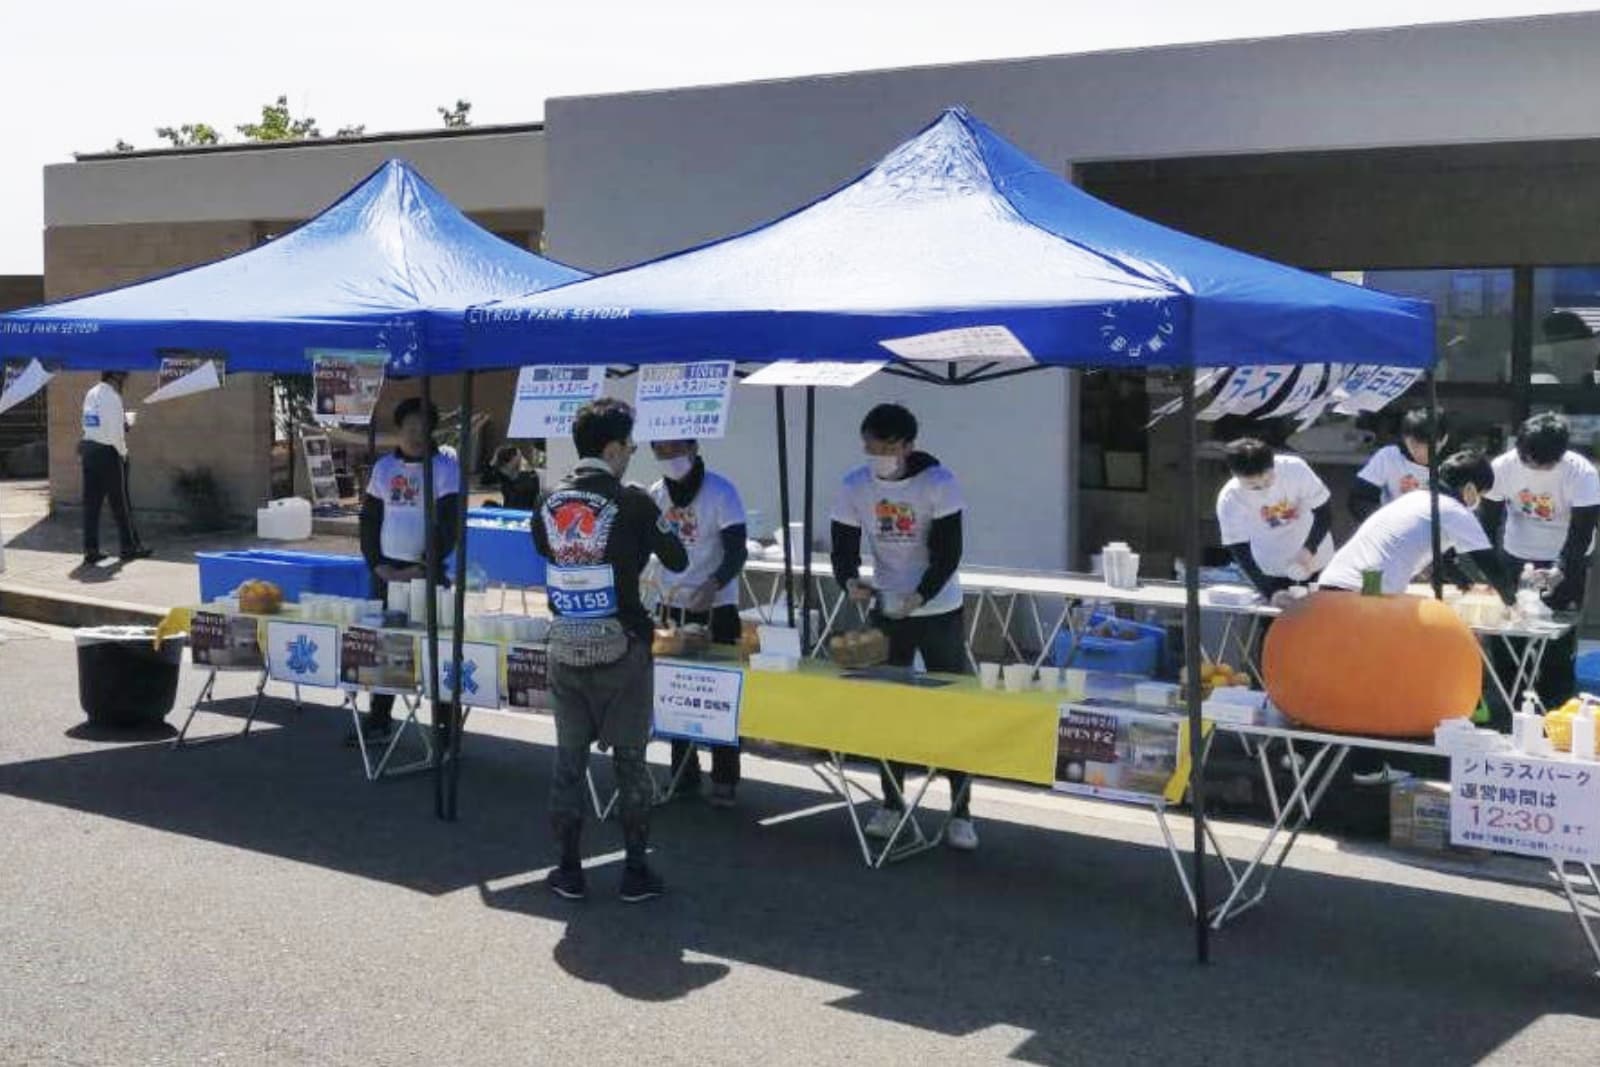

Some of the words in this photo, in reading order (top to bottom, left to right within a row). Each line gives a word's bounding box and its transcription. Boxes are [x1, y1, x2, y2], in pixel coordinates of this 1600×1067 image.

[470, 308, 522, 324] CITRUS
[527, 307, 568, 321] PARK
[570, 306, 633, 321] SETODA
[551, 590, 610, 609] 2515B
[1460, 782, 1557, 808] 運営時間は
[1470, 805, 1555, 835] 12:30
